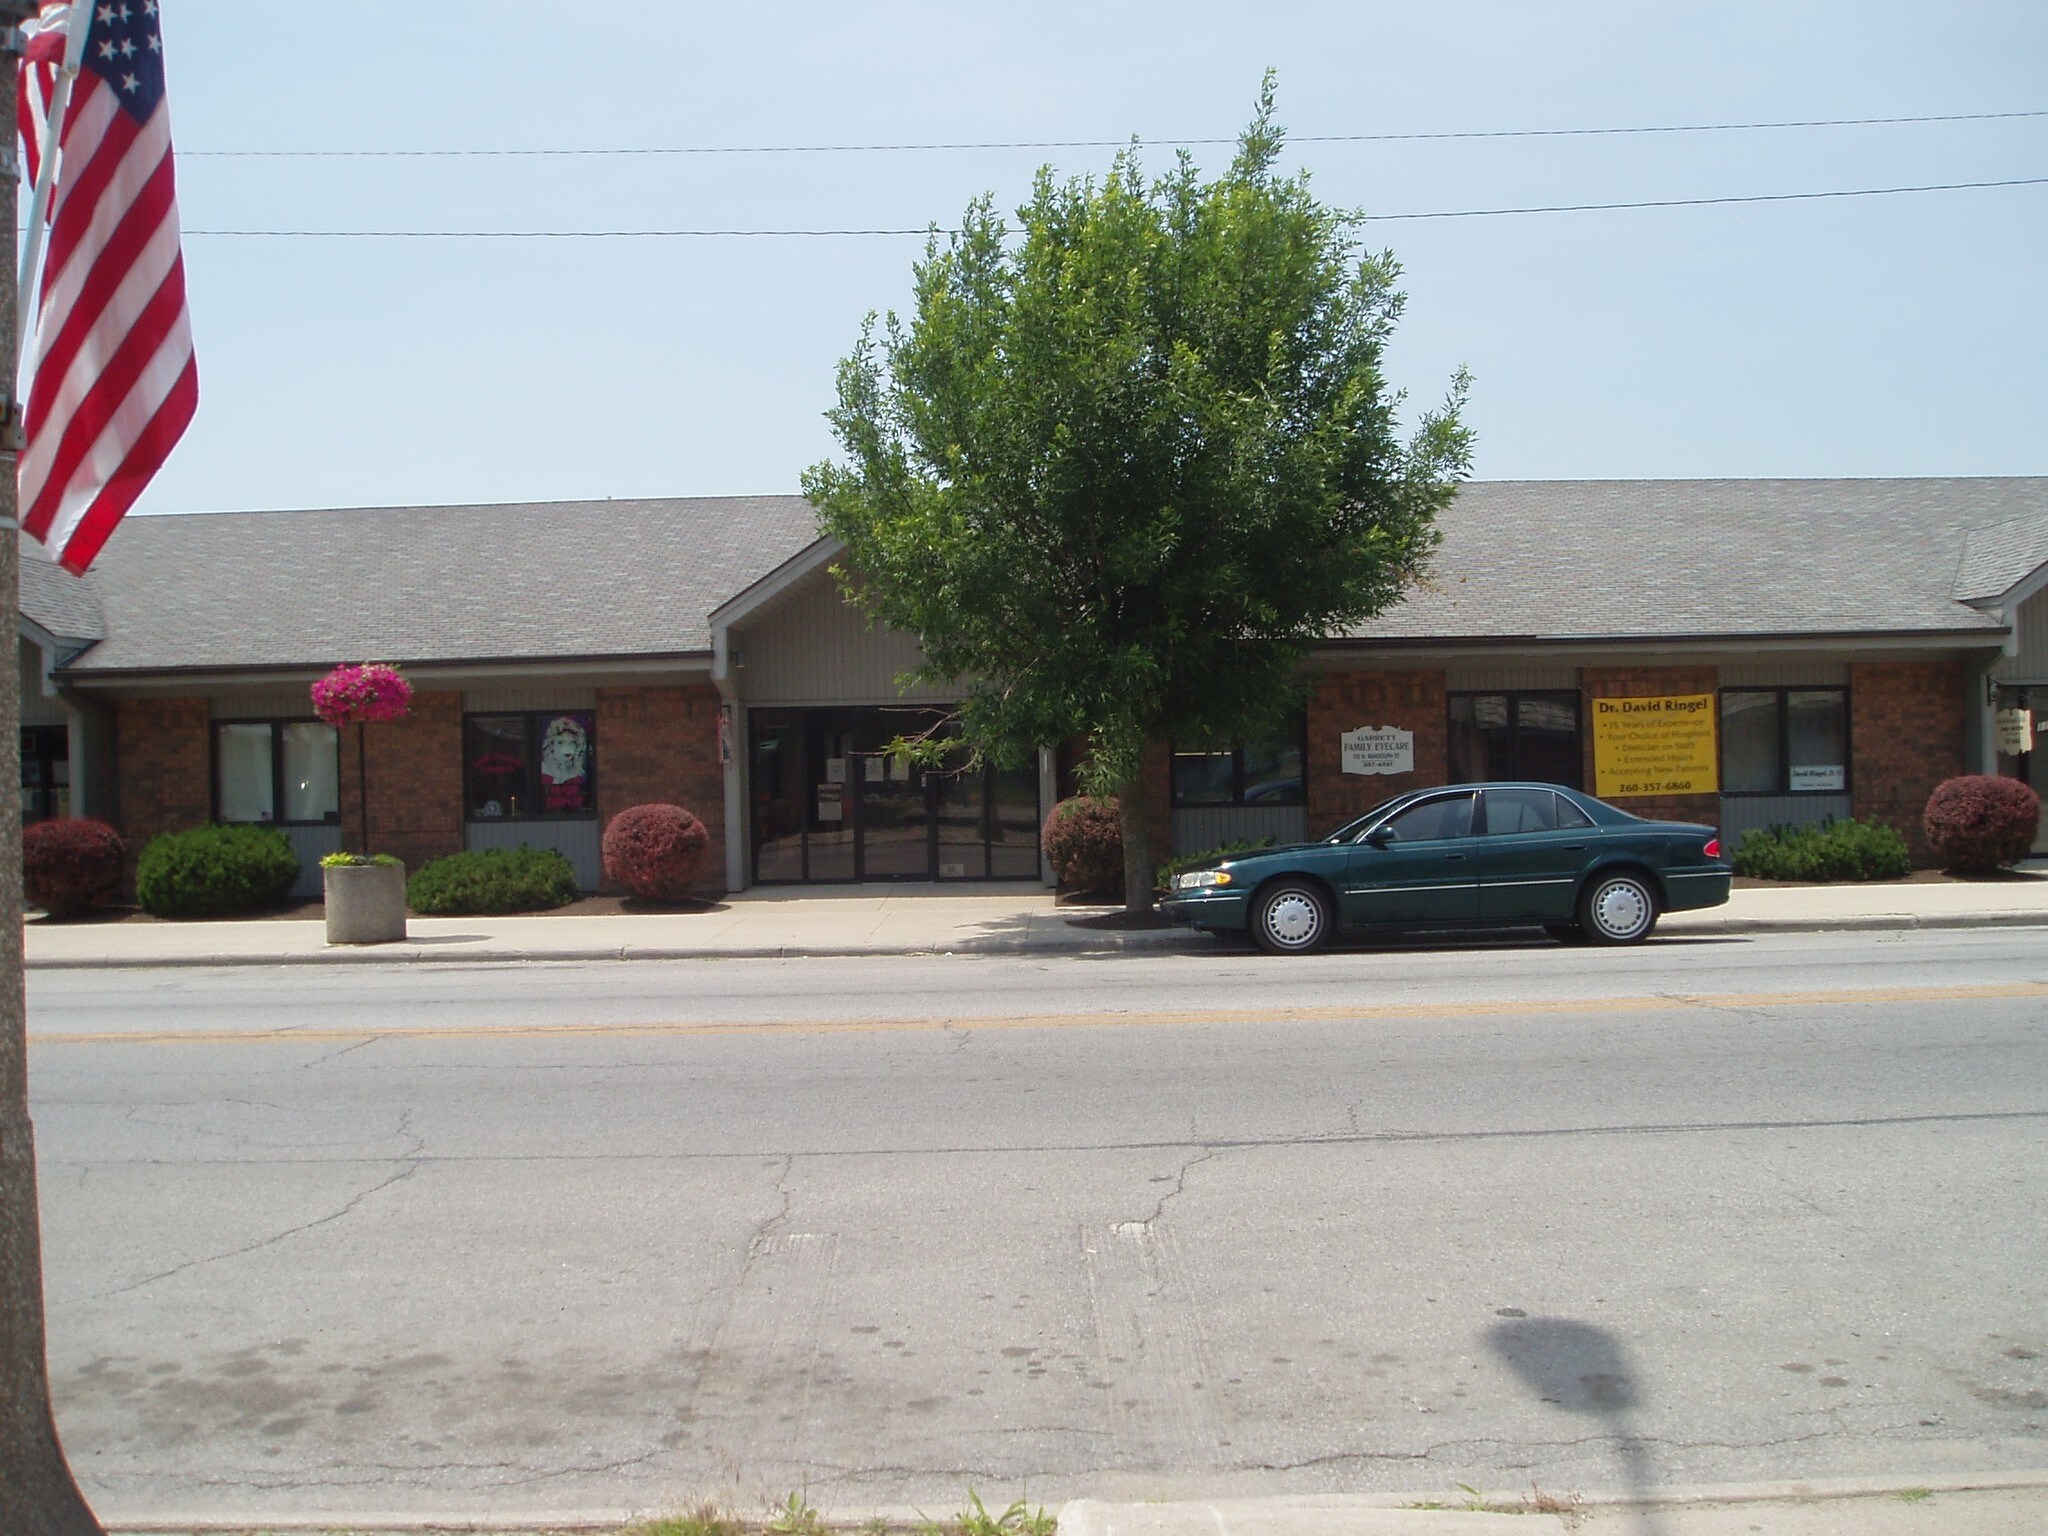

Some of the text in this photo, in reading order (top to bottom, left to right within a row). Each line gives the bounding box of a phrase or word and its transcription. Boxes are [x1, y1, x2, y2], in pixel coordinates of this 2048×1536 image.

[1599, 699, 1707, 713] Dr. David Ringel
[1621, 721, 1645, 729] Years
[1647, 720, 1655, 728] of
[1658, 720, 1705, 729] Experience
[1607, 730, 1711, 740] Your Choice of Hospitals
[1344, 742, 1410, 751] FAMILY EYECARE
[1675, 742, 1695, 750] Staff
[1624, 754, 1694, 763] Extended Hours
[1609, 767, 1653, 776] Accepting
[1676, 765, 1710, 773] Patients
[1620, 781, 1692, 793] 260-357-6860
